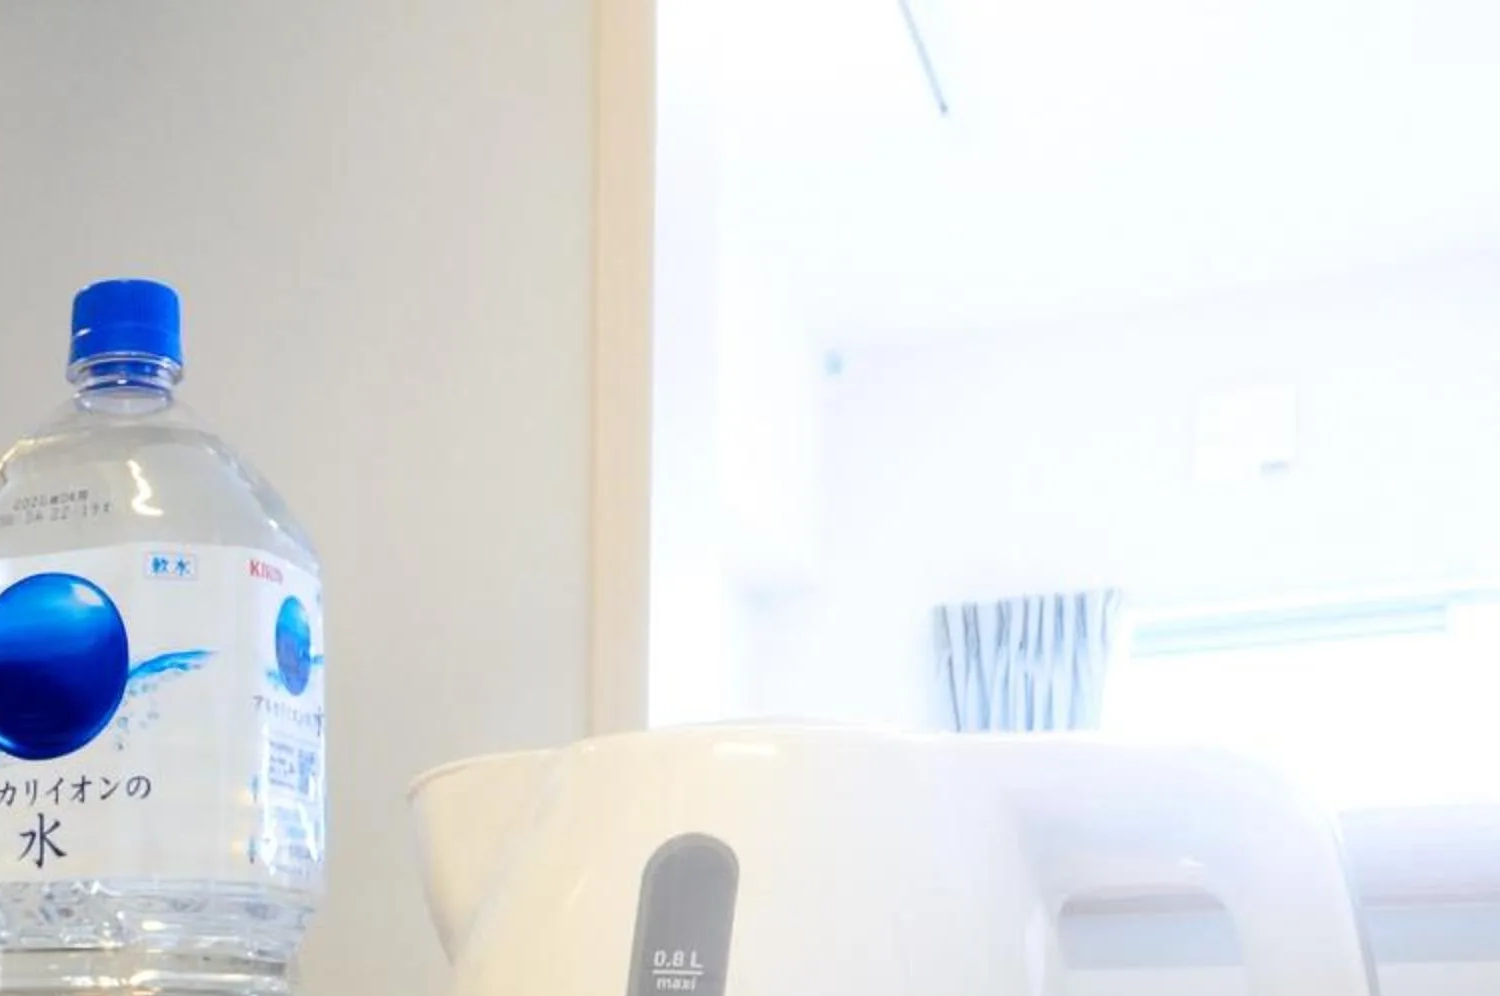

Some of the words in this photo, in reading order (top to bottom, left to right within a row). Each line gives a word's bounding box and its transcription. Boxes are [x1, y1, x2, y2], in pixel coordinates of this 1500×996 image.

[18, 812, 67, 868] 水
[689, 949, 704, 968] L
[656, 975, 697, 991] maxi
